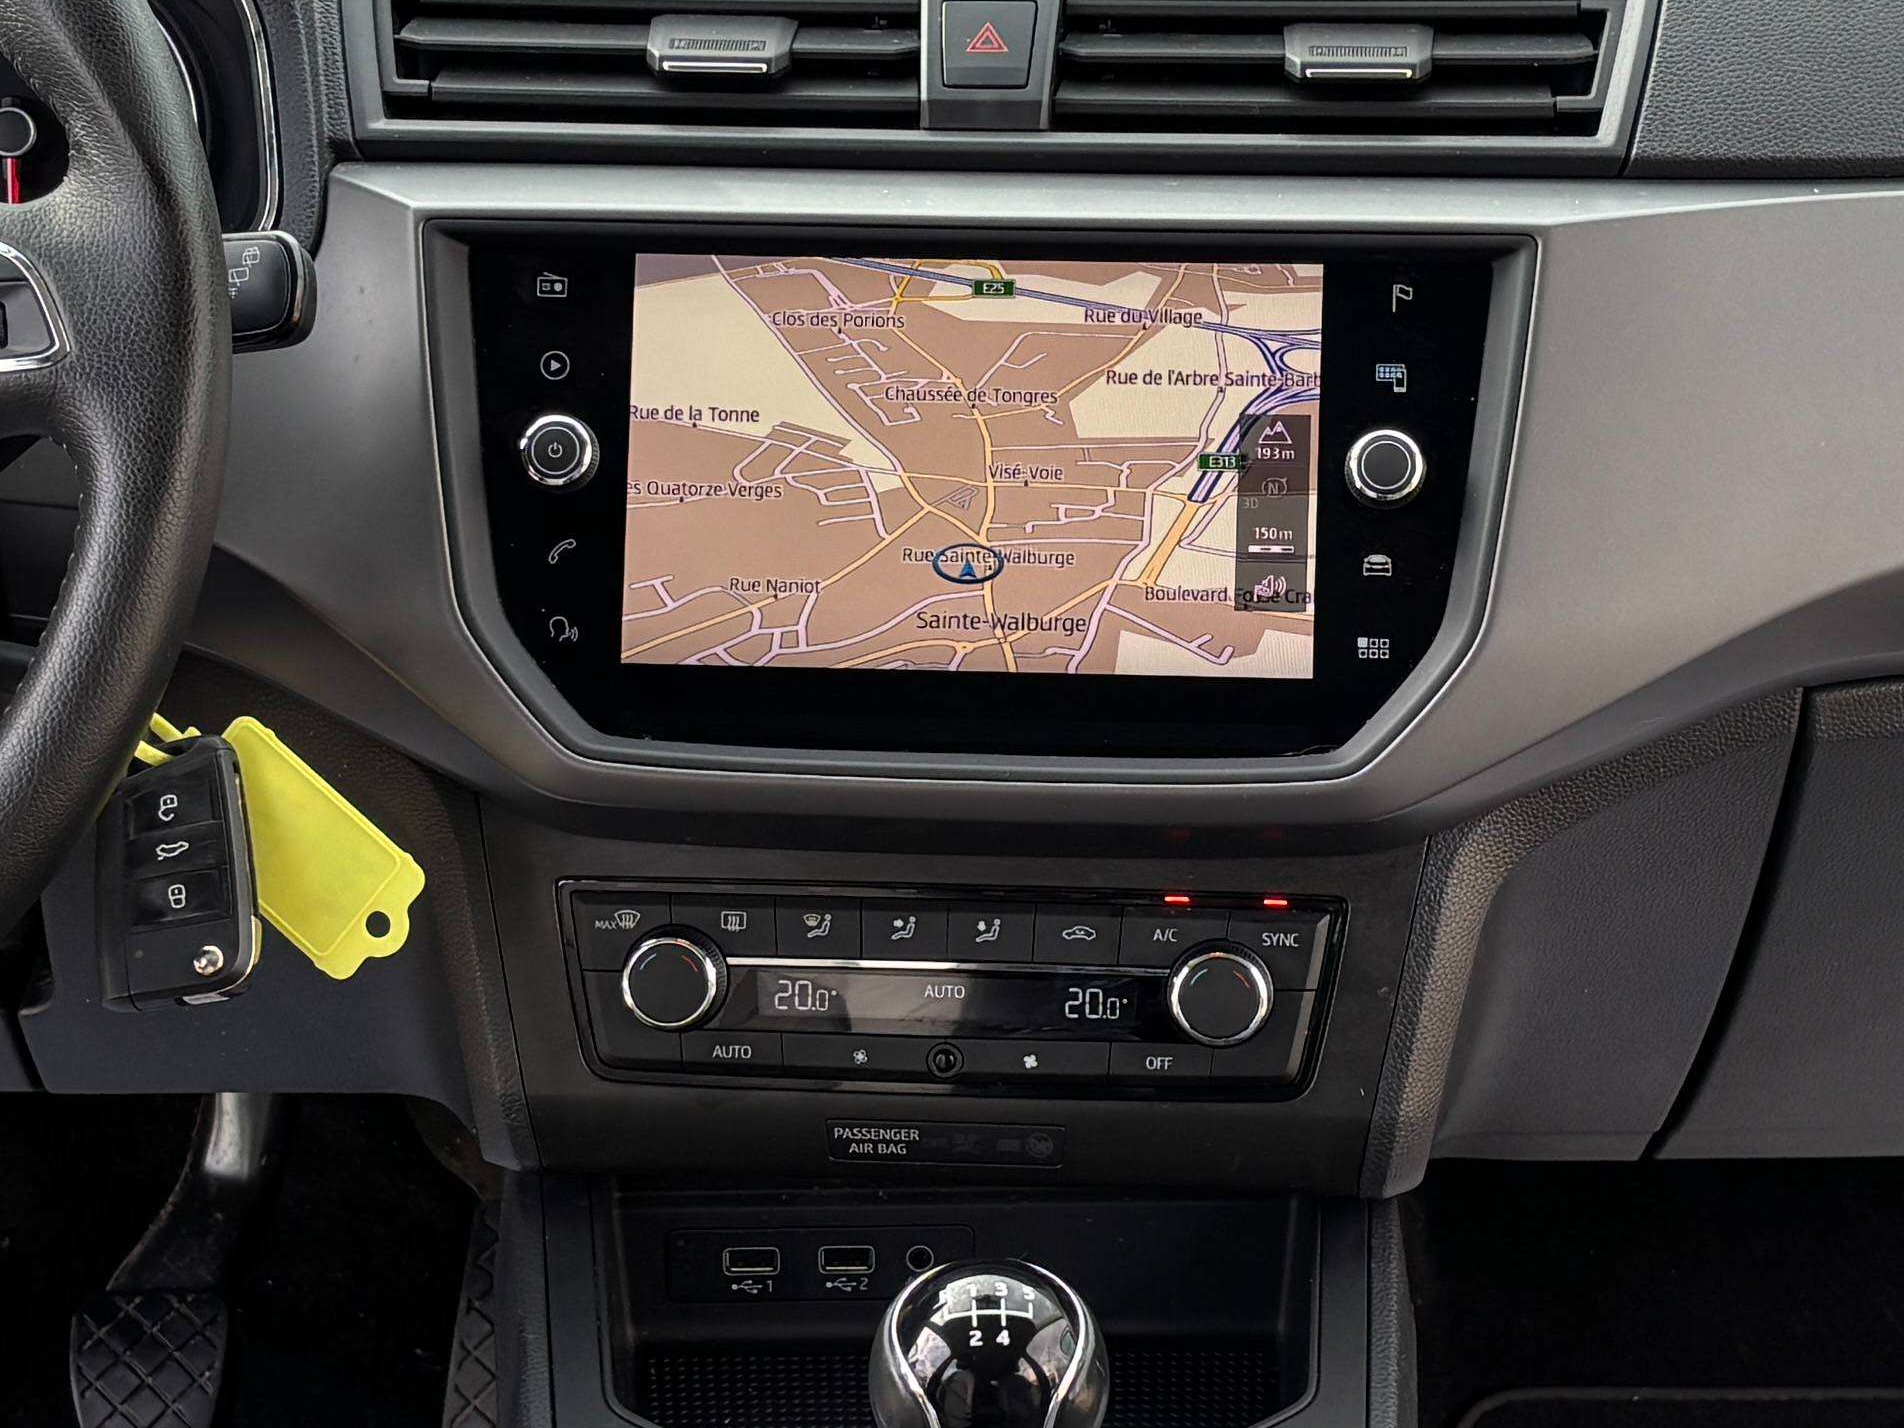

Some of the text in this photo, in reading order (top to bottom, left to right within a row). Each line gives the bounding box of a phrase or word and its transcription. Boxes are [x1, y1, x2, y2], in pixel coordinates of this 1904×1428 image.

[772, 312, 905, 329] Clos des Porions
[1083, 309, 1202, 328] Rue du Village
[1106, 370, 1138, 385] Rue
[1141, 370, 1163, 386] de
[1167, 370, 1219, 386] l'Arbre
[885, 386, 1058, 406] Chaussée de Tongres
[629, 405, 760, 422] Rue de la Tonne
[647, 480, 723, 497] Quatorze
[728, 483, 782, 501] Verges
[902, 548, 1075, 569] Rue SainteWalburge
[730, 578, 822, 594] Rue Naniot
[1145, 586, 1228, 603] Boulevard
[916, 611, 1087, 635] Sainte-Walburge
[1152, 927, 1179, 943] A/C
[1261, 932, 1299, 947] SYNC
[924, 984, 966, 1000] AUTO
[711, 1044, 752, 1060] AUTO
[1145, 1055, 1173, 1071] OFF
[833, 1127, 920, 1141] PASSENGER
[848, 1142, 907, 1155] AIR BAG
[859, 1277, 869, 1291] 2
[969, 1329, 1011, 1347] 2 4
